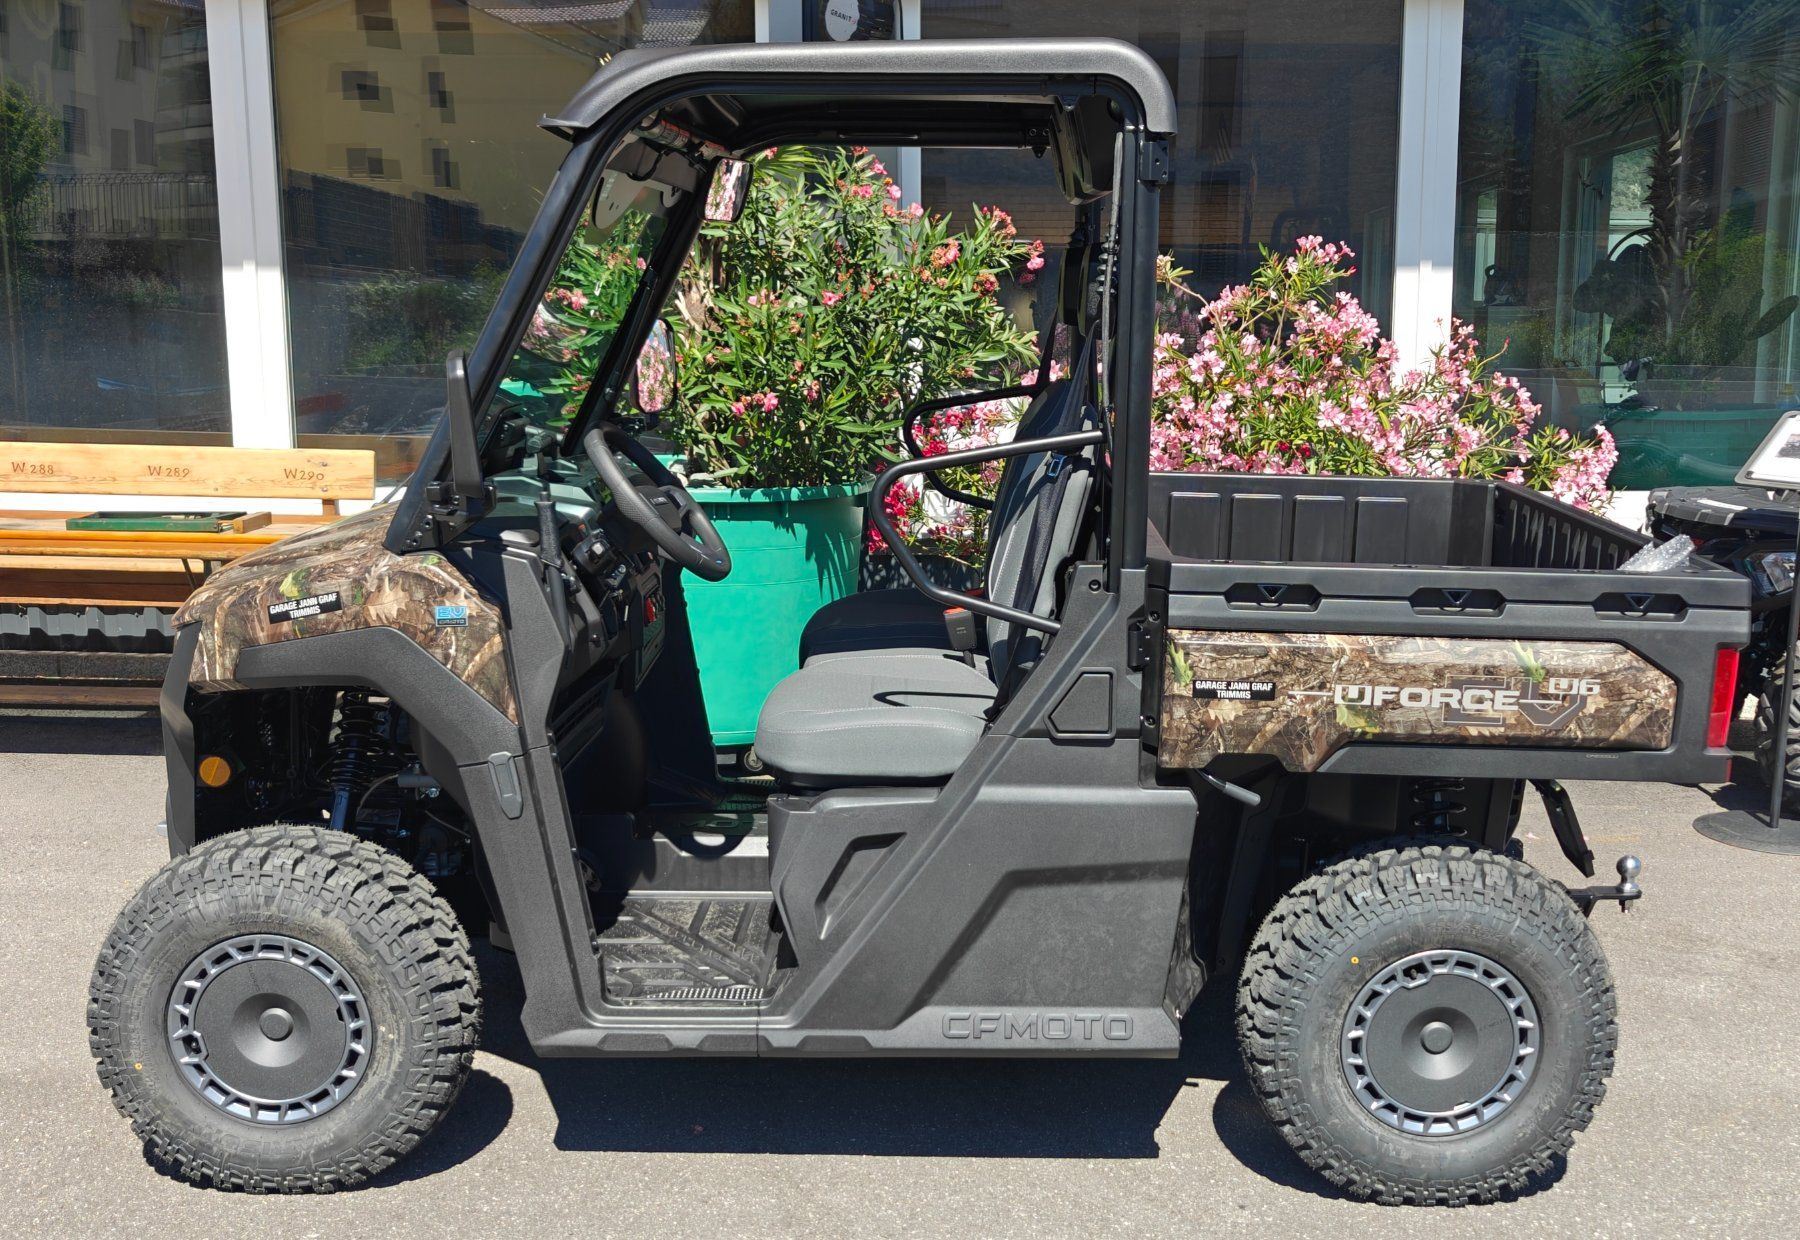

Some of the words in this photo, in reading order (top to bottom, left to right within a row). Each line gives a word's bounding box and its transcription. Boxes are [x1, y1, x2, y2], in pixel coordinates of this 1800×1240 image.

[830, 9, 852, 22] GRANIT
[30, 464, 54, 475] 288
[166, 466, 190, 478] 289
[270, 601, 298, 614] GARAGE
[299, 597, 318, 608] JANN
[318, 592, 338, 604] GRAF
[290, 605, 320, 618] TRIMMIS
[437, 606, 465, 618] EV
[1195, 681, 1227, 690] GARAGE
[1228, 682, 1250, 691] JANN
[1252, 682, 1273, 691] GRAF
[1216, 690, 1251, 699] TRIMMIS
[942, 1012, 1134, 1040] CFMOTO
